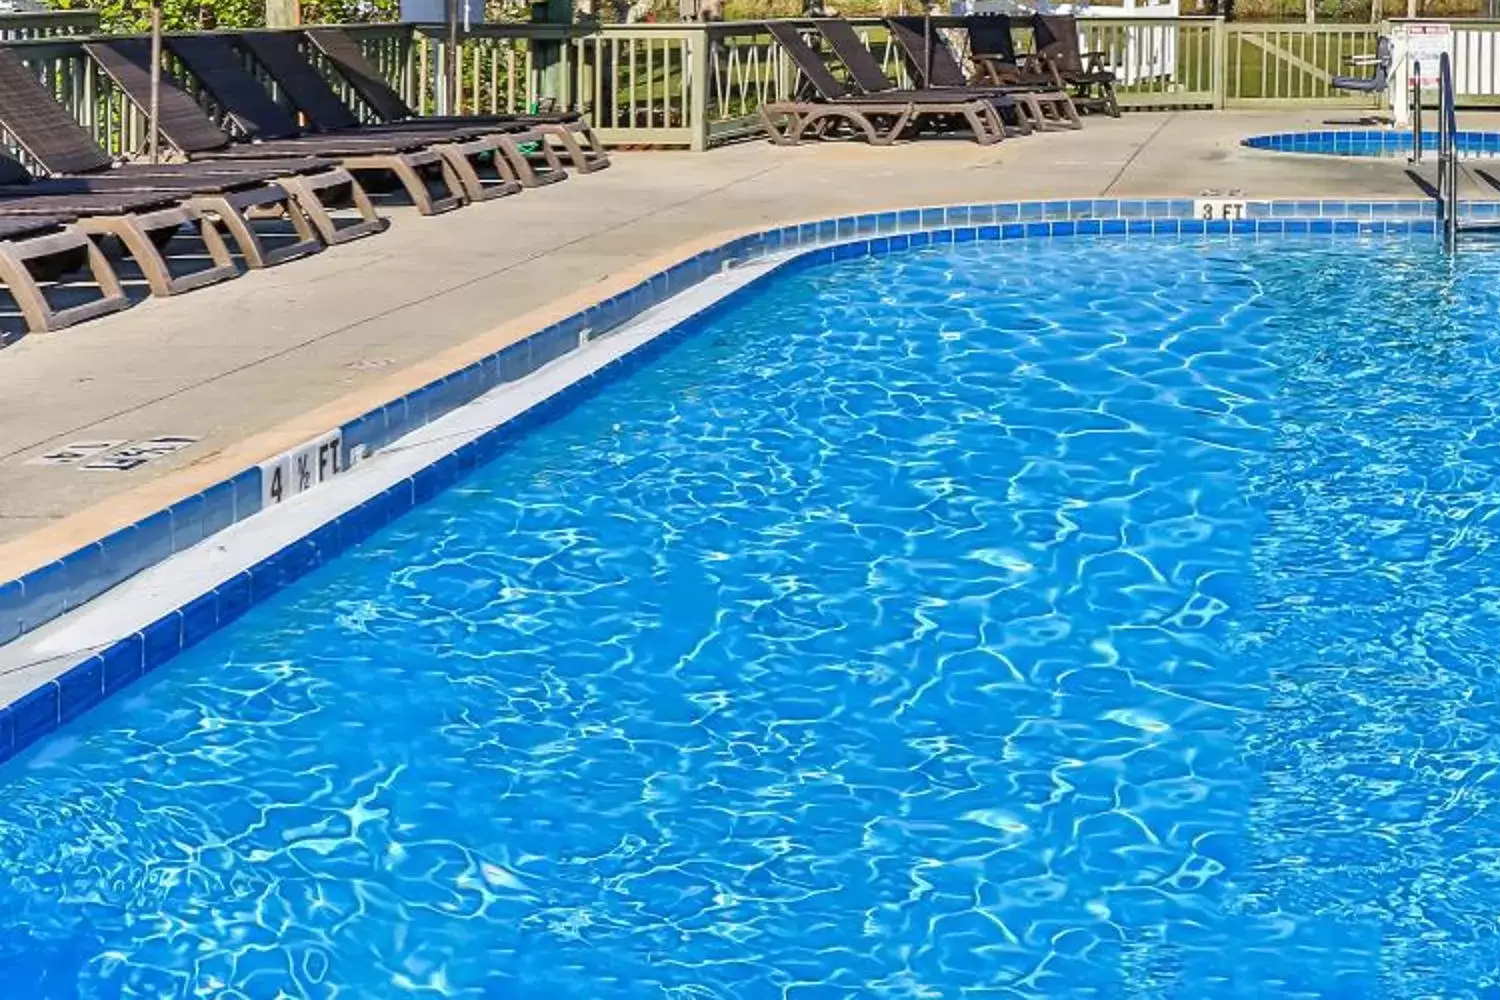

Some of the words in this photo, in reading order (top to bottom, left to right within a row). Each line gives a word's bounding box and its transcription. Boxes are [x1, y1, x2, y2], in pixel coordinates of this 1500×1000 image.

[1203, 203, 1213, 220] 3
[1223, 204, 1243, 220] FT
[270, 466, 283, 503] 4
